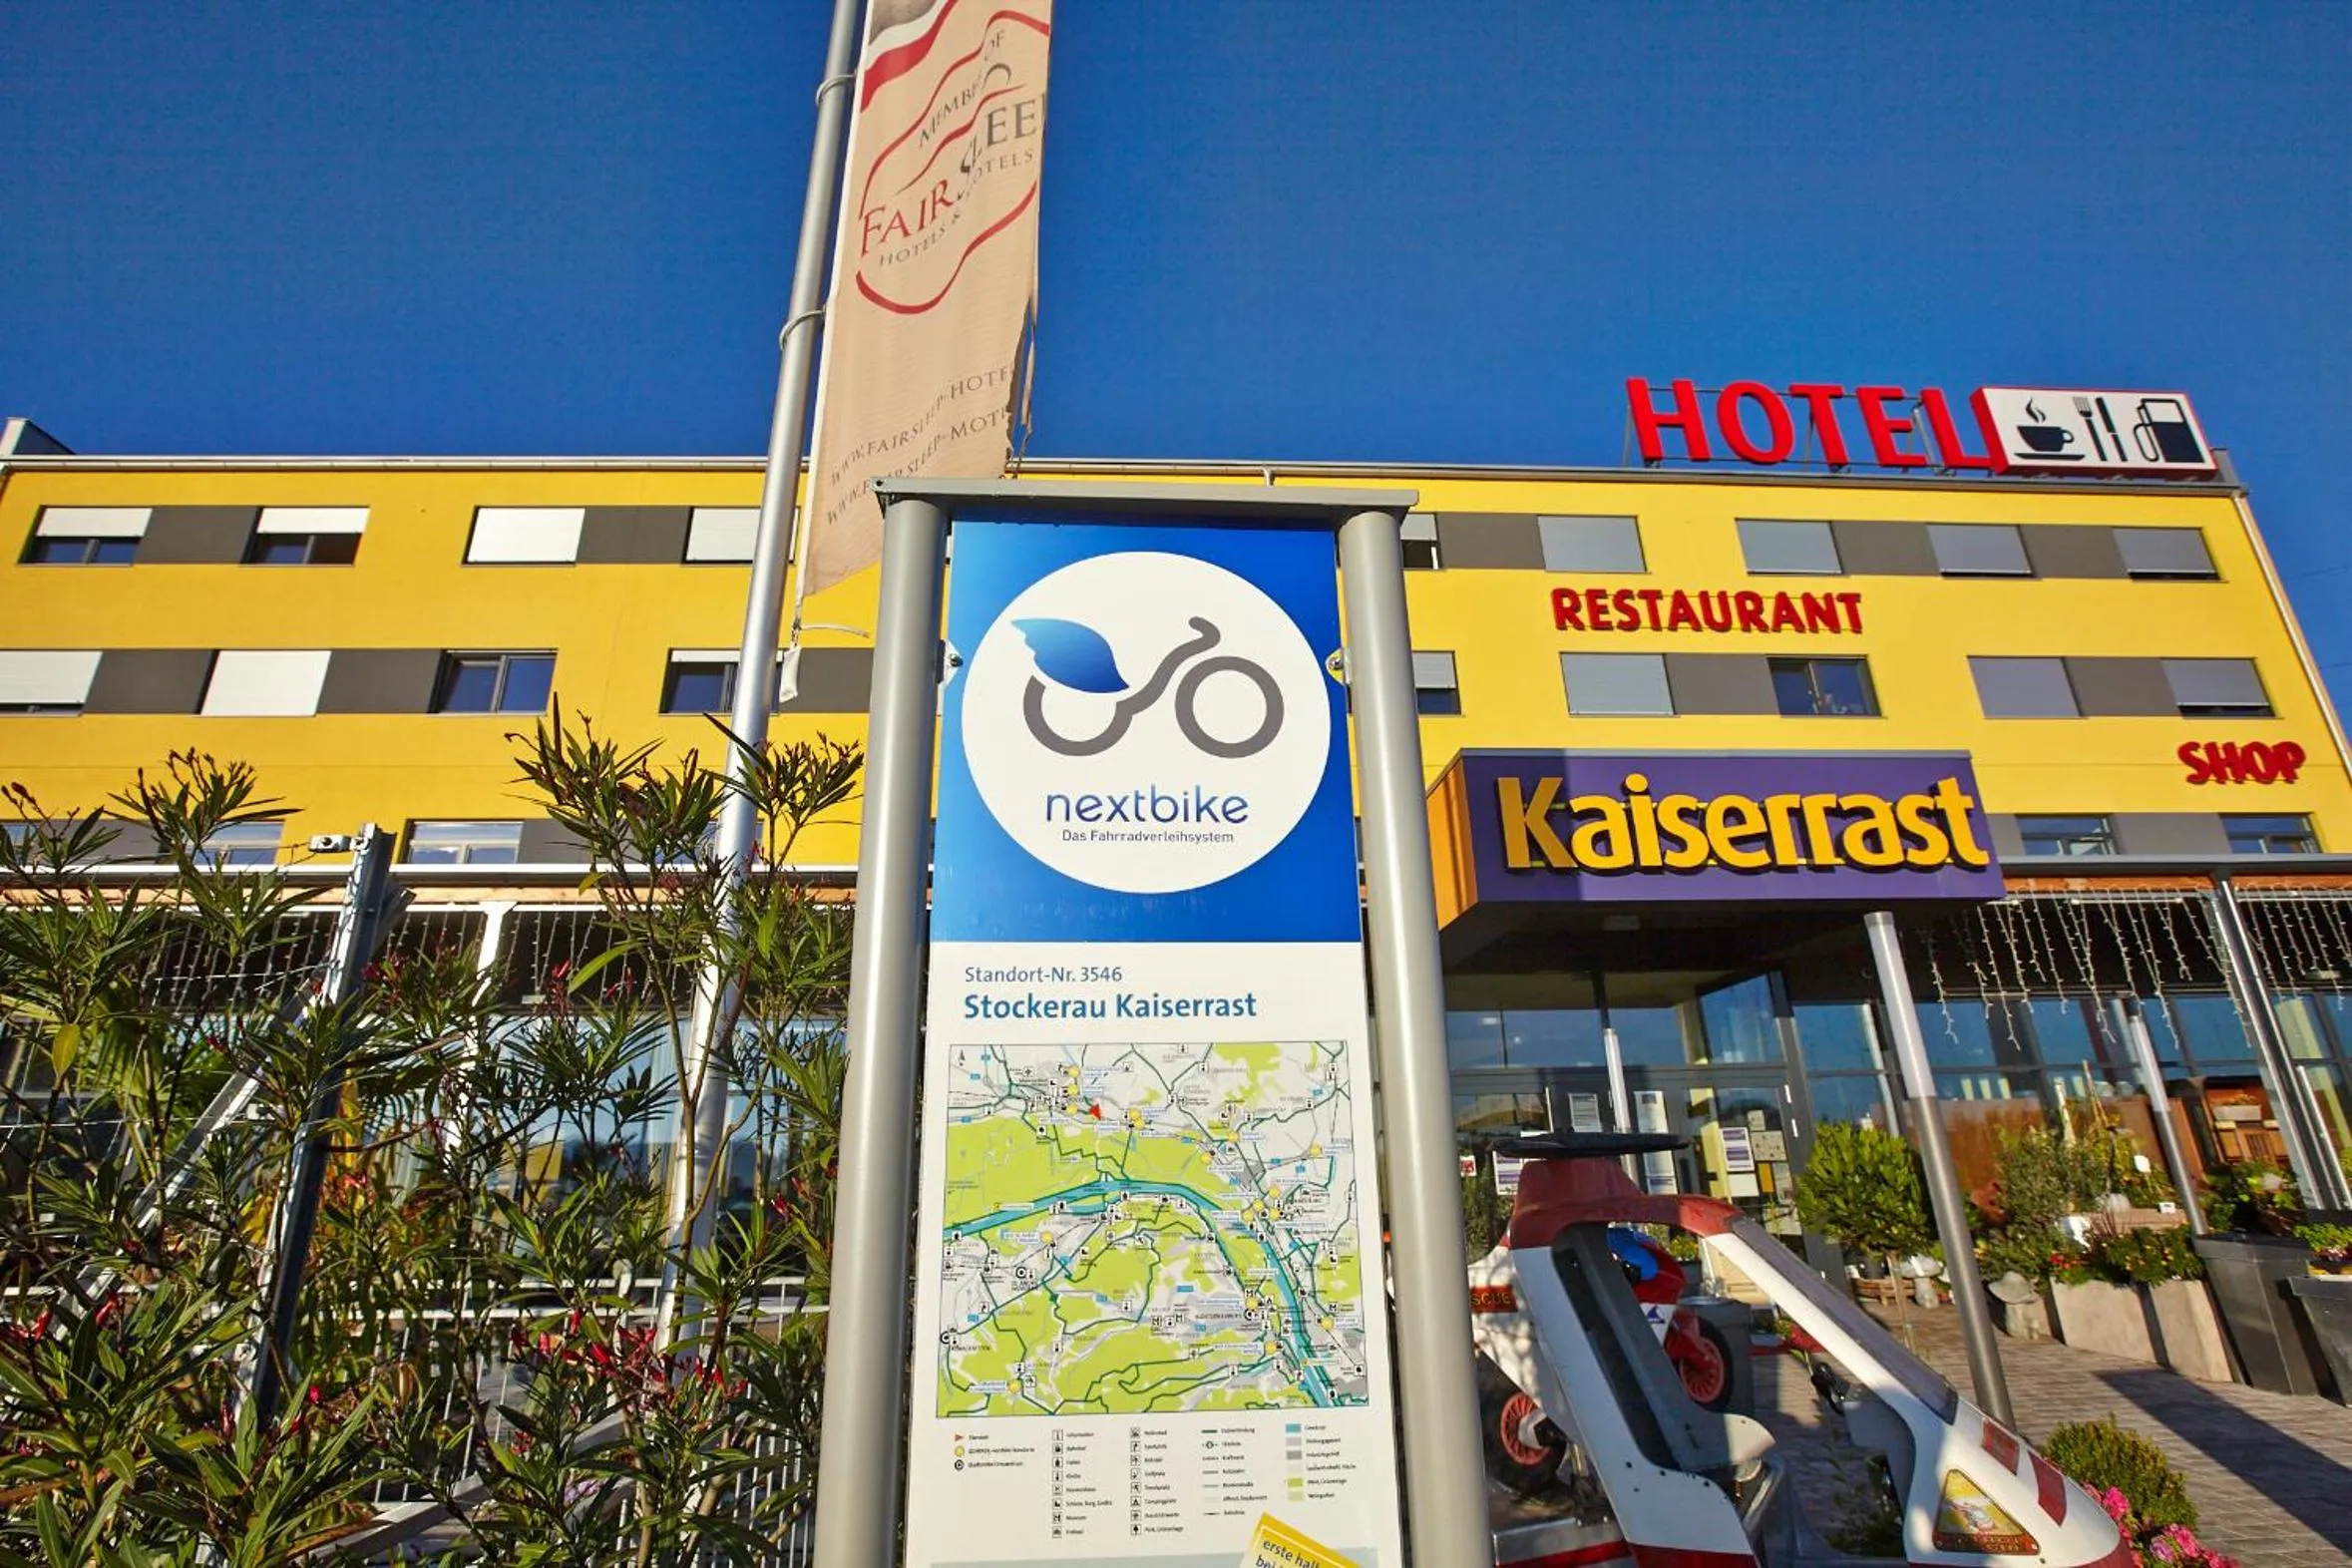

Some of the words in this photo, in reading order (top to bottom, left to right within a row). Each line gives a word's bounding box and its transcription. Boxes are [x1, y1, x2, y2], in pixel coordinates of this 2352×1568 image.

[1626, 378, 1993, 470] HOTEL
[1550, 588, 1862, 634] RESTAURANT
[2177, 741, 2306, 785] SHOP
[1045, 783, 1250, 824] nextbike
[1496, 773, 1991, 871] Kaiserrast
[1061, 829, 1087, 843] Das
[1090, 829, 1234, 845] Fahrradverleihsystem
[964, 966, 1076, 983] Standort-Nr.
[1079, 966, 1123, 983] 3546
[964, 993, 1107, 1019] Stockerau
[1115, 992, 1258, 1018] Kaiserrast
[1262, 1539, 1294, 1561] erste
